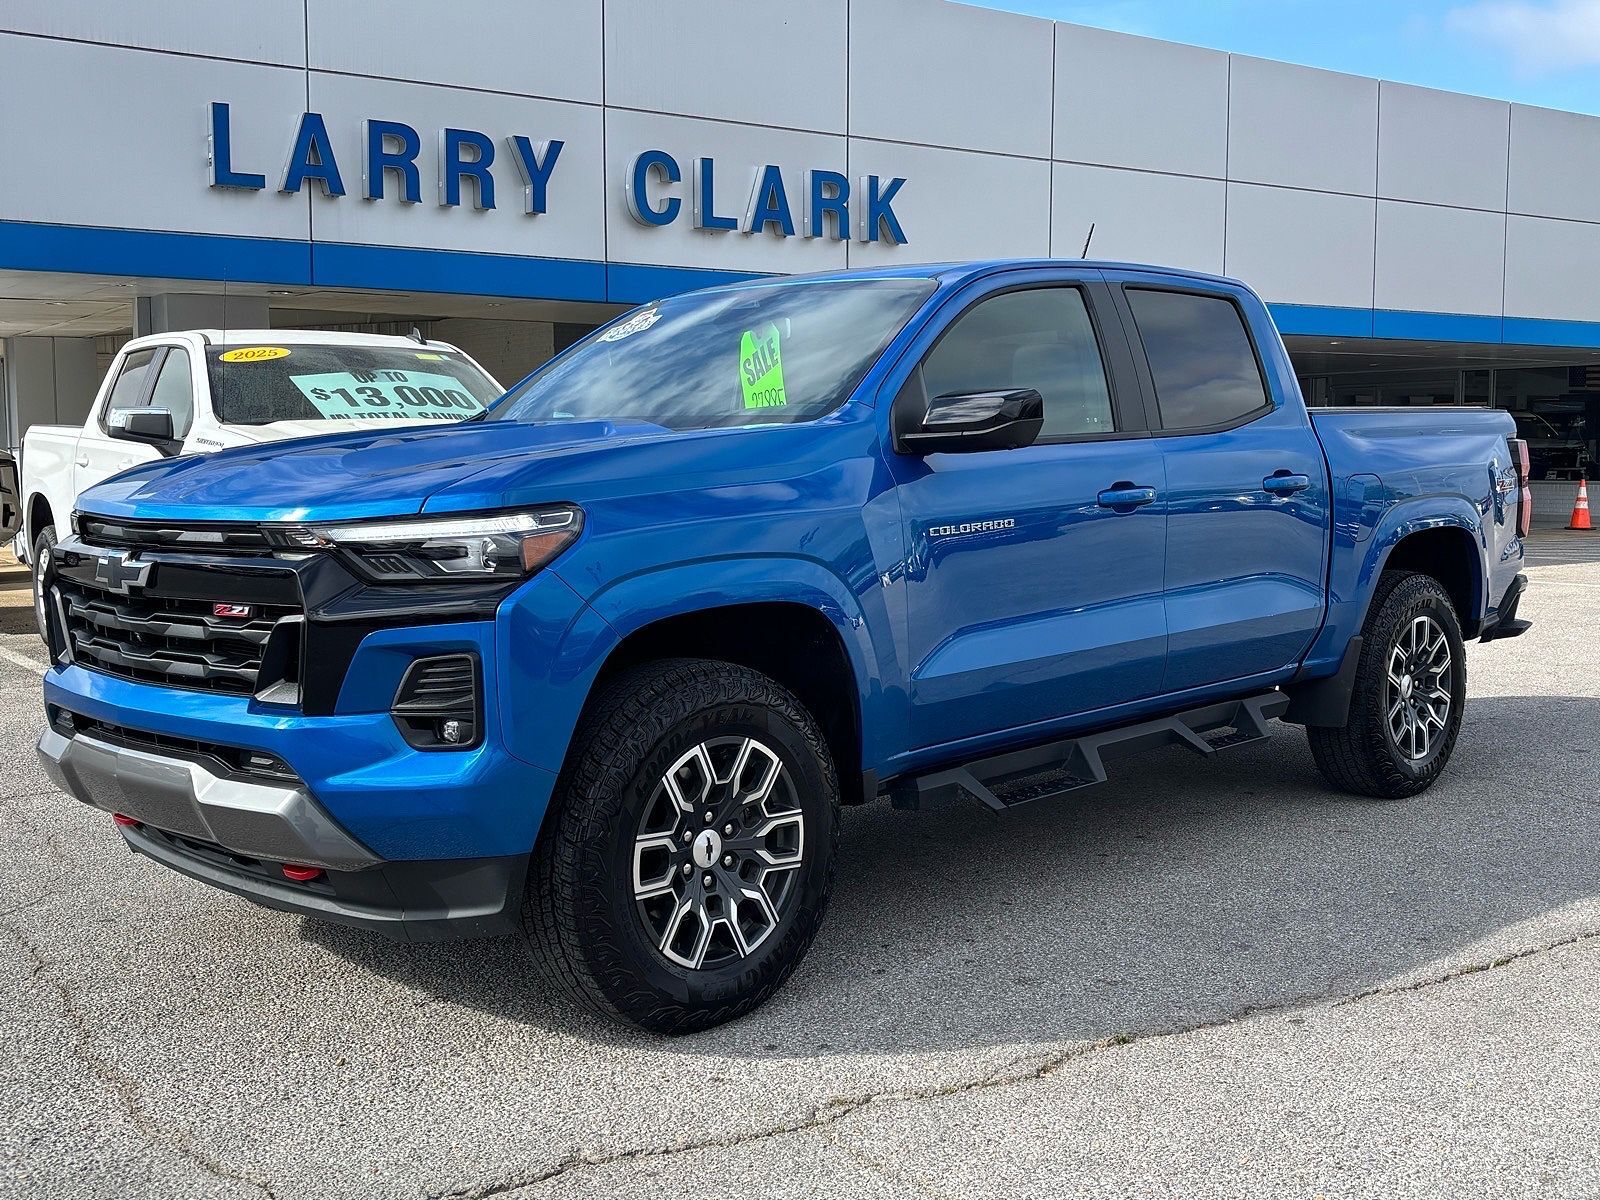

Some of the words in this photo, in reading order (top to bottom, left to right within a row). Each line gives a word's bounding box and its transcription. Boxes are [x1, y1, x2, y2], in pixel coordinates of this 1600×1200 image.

[207, 101, 565, 215] LARRY
[625, 149, 909, 245] CLARK
[233, 349, 278, 361] 2025
[743, 337, 779, 387] SALE
[352, 370, 378, 384] UP
[380, 371, 408, 383] TO
[310, 385, 477, 411] $13,000
[929, 518, 1015, 537] COLORADO
[213, 604, 250, 617] Z71
